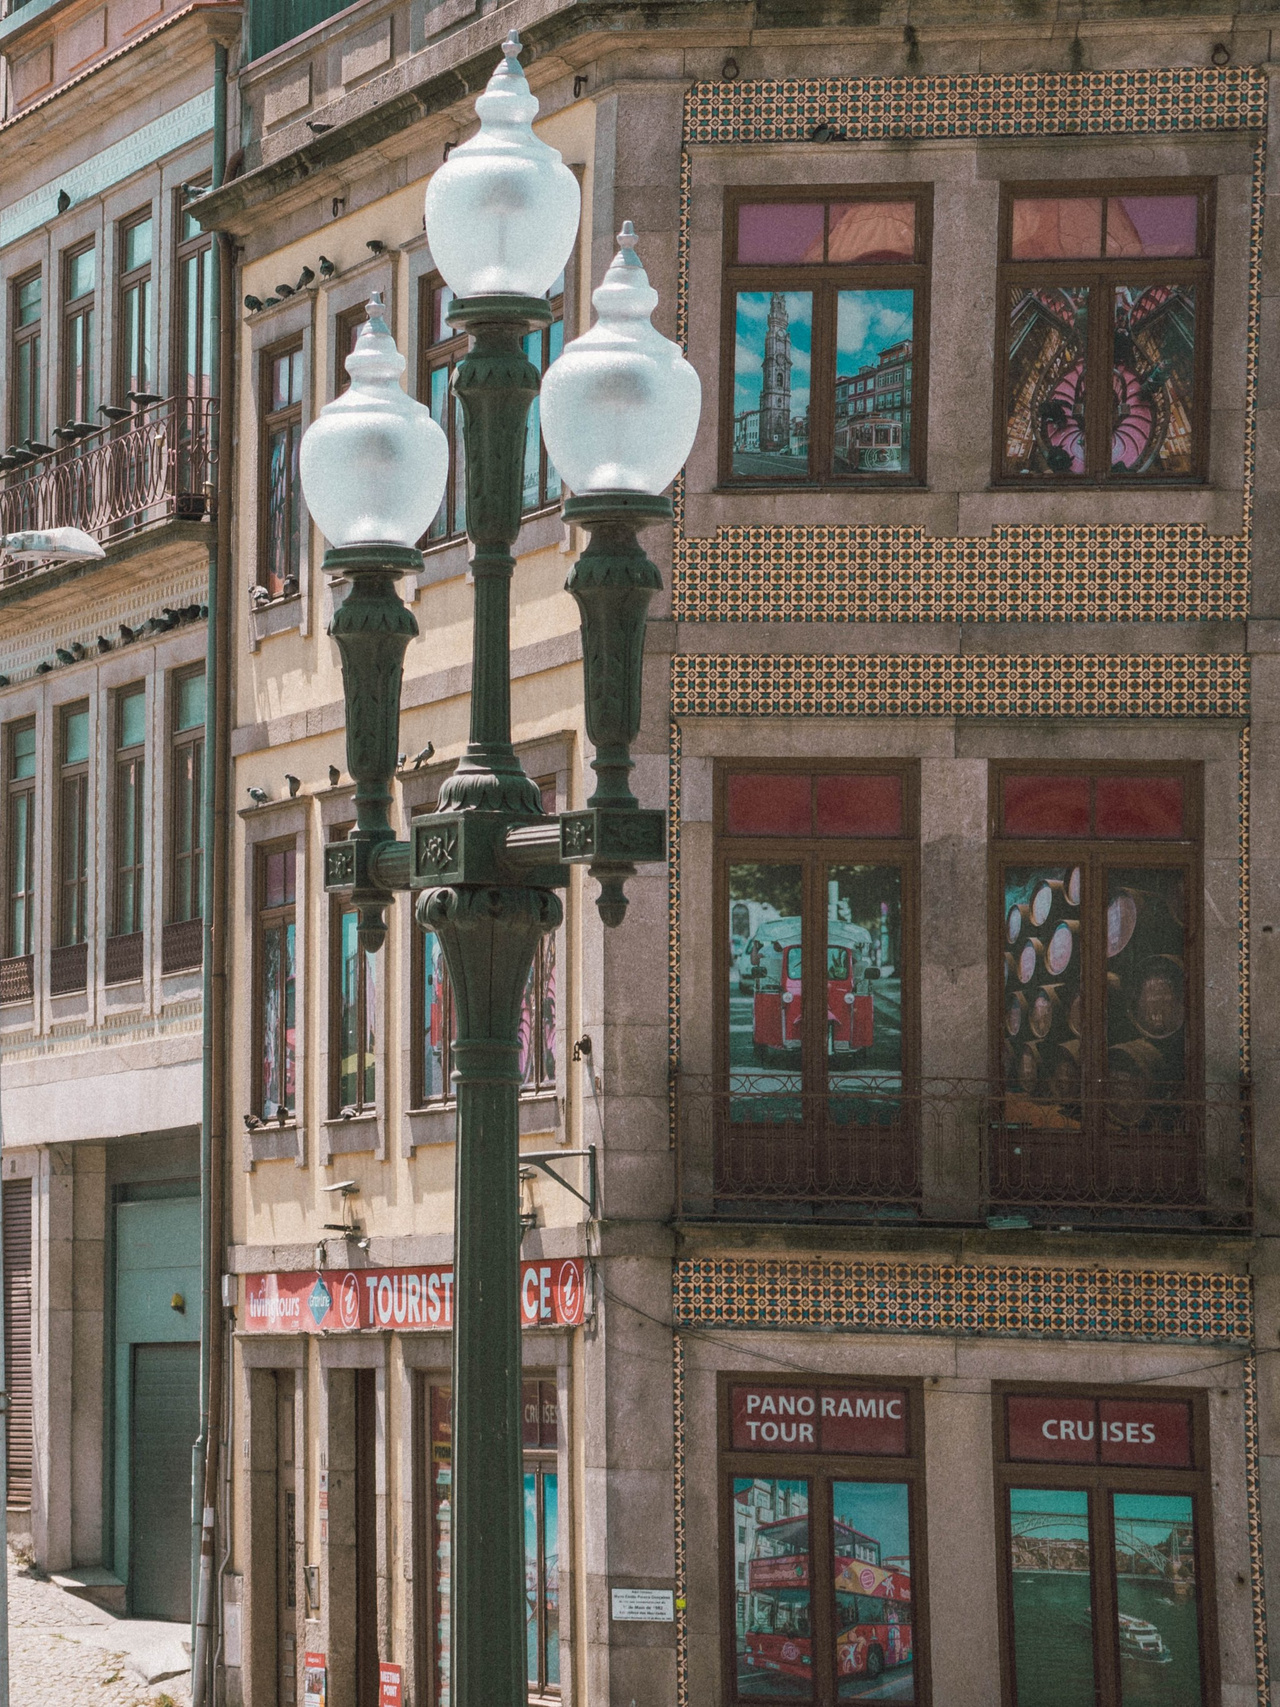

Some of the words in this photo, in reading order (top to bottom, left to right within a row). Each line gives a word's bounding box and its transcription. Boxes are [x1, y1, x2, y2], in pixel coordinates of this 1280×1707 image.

[366, 1272, 454, 1324] TOURIST
[746, 1421, 814, 1443] TOUR
[1042, 1419, 1156, 1444] CRUISES
